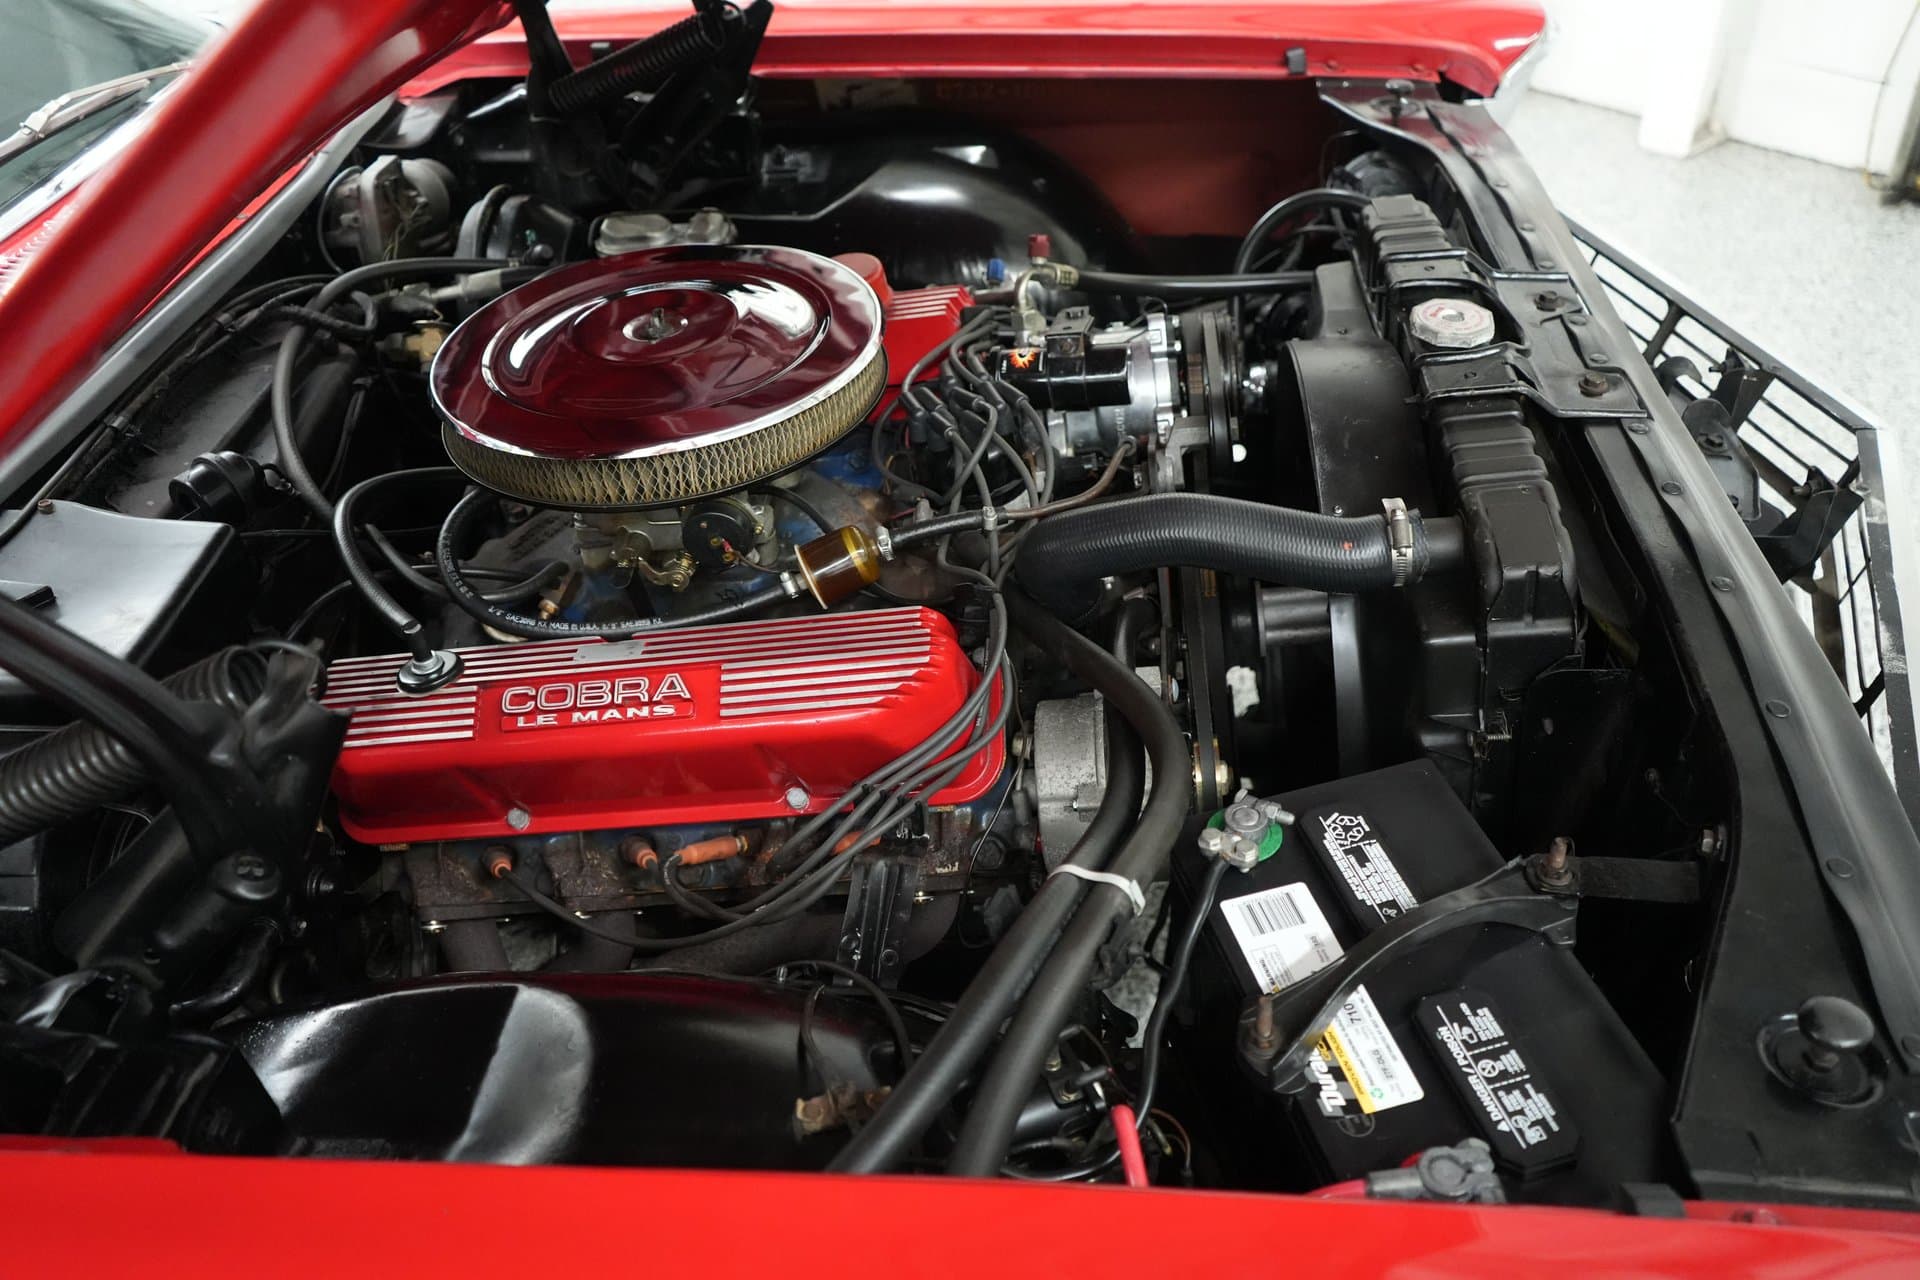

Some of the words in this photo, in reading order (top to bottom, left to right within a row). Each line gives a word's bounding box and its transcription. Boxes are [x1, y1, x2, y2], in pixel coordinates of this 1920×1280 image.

[502, 673, 691, 713] COBRA
[517, 714, 558, 727] LE
[572, 705, 676, 723] MANS
[1344, 1003, 1361, 1025] 710
[1437, 1026, 1469, 1066] POISON
[1467, 1074, 1503, 1121] DANGER
